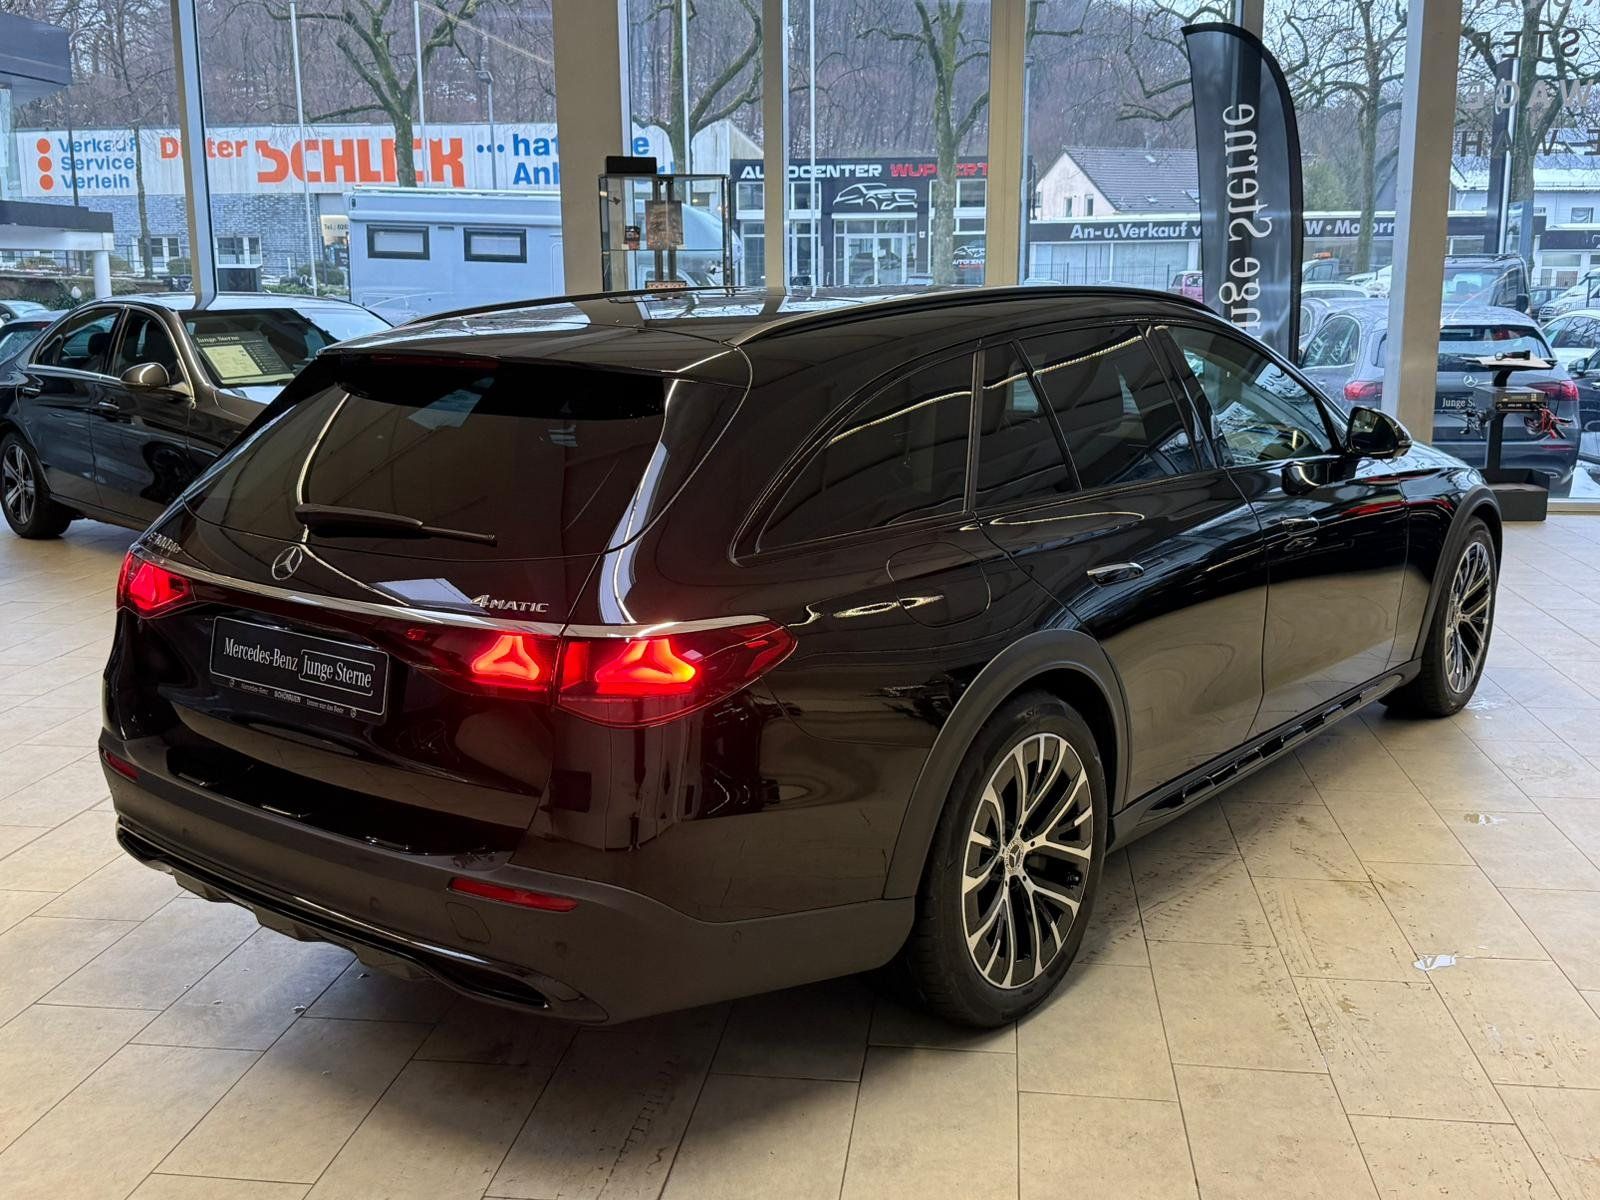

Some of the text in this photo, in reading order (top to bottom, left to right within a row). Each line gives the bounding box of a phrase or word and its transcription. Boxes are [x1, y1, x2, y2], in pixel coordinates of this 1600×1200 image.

[58, 137, 136, 153] Verkauf
[160, 137, 248, 159] Dter
[61, 156, 135, 171] Service
[740, 164, 882, 179] AUOCENTER
[61, 174, 130, 189] Verleih
[1442, 398, 1466, 410] Junge
[470, 594, 550, 613] 4MATIC
[223, 637, 372, 688] Mercedes-Benz Junge Sterne
